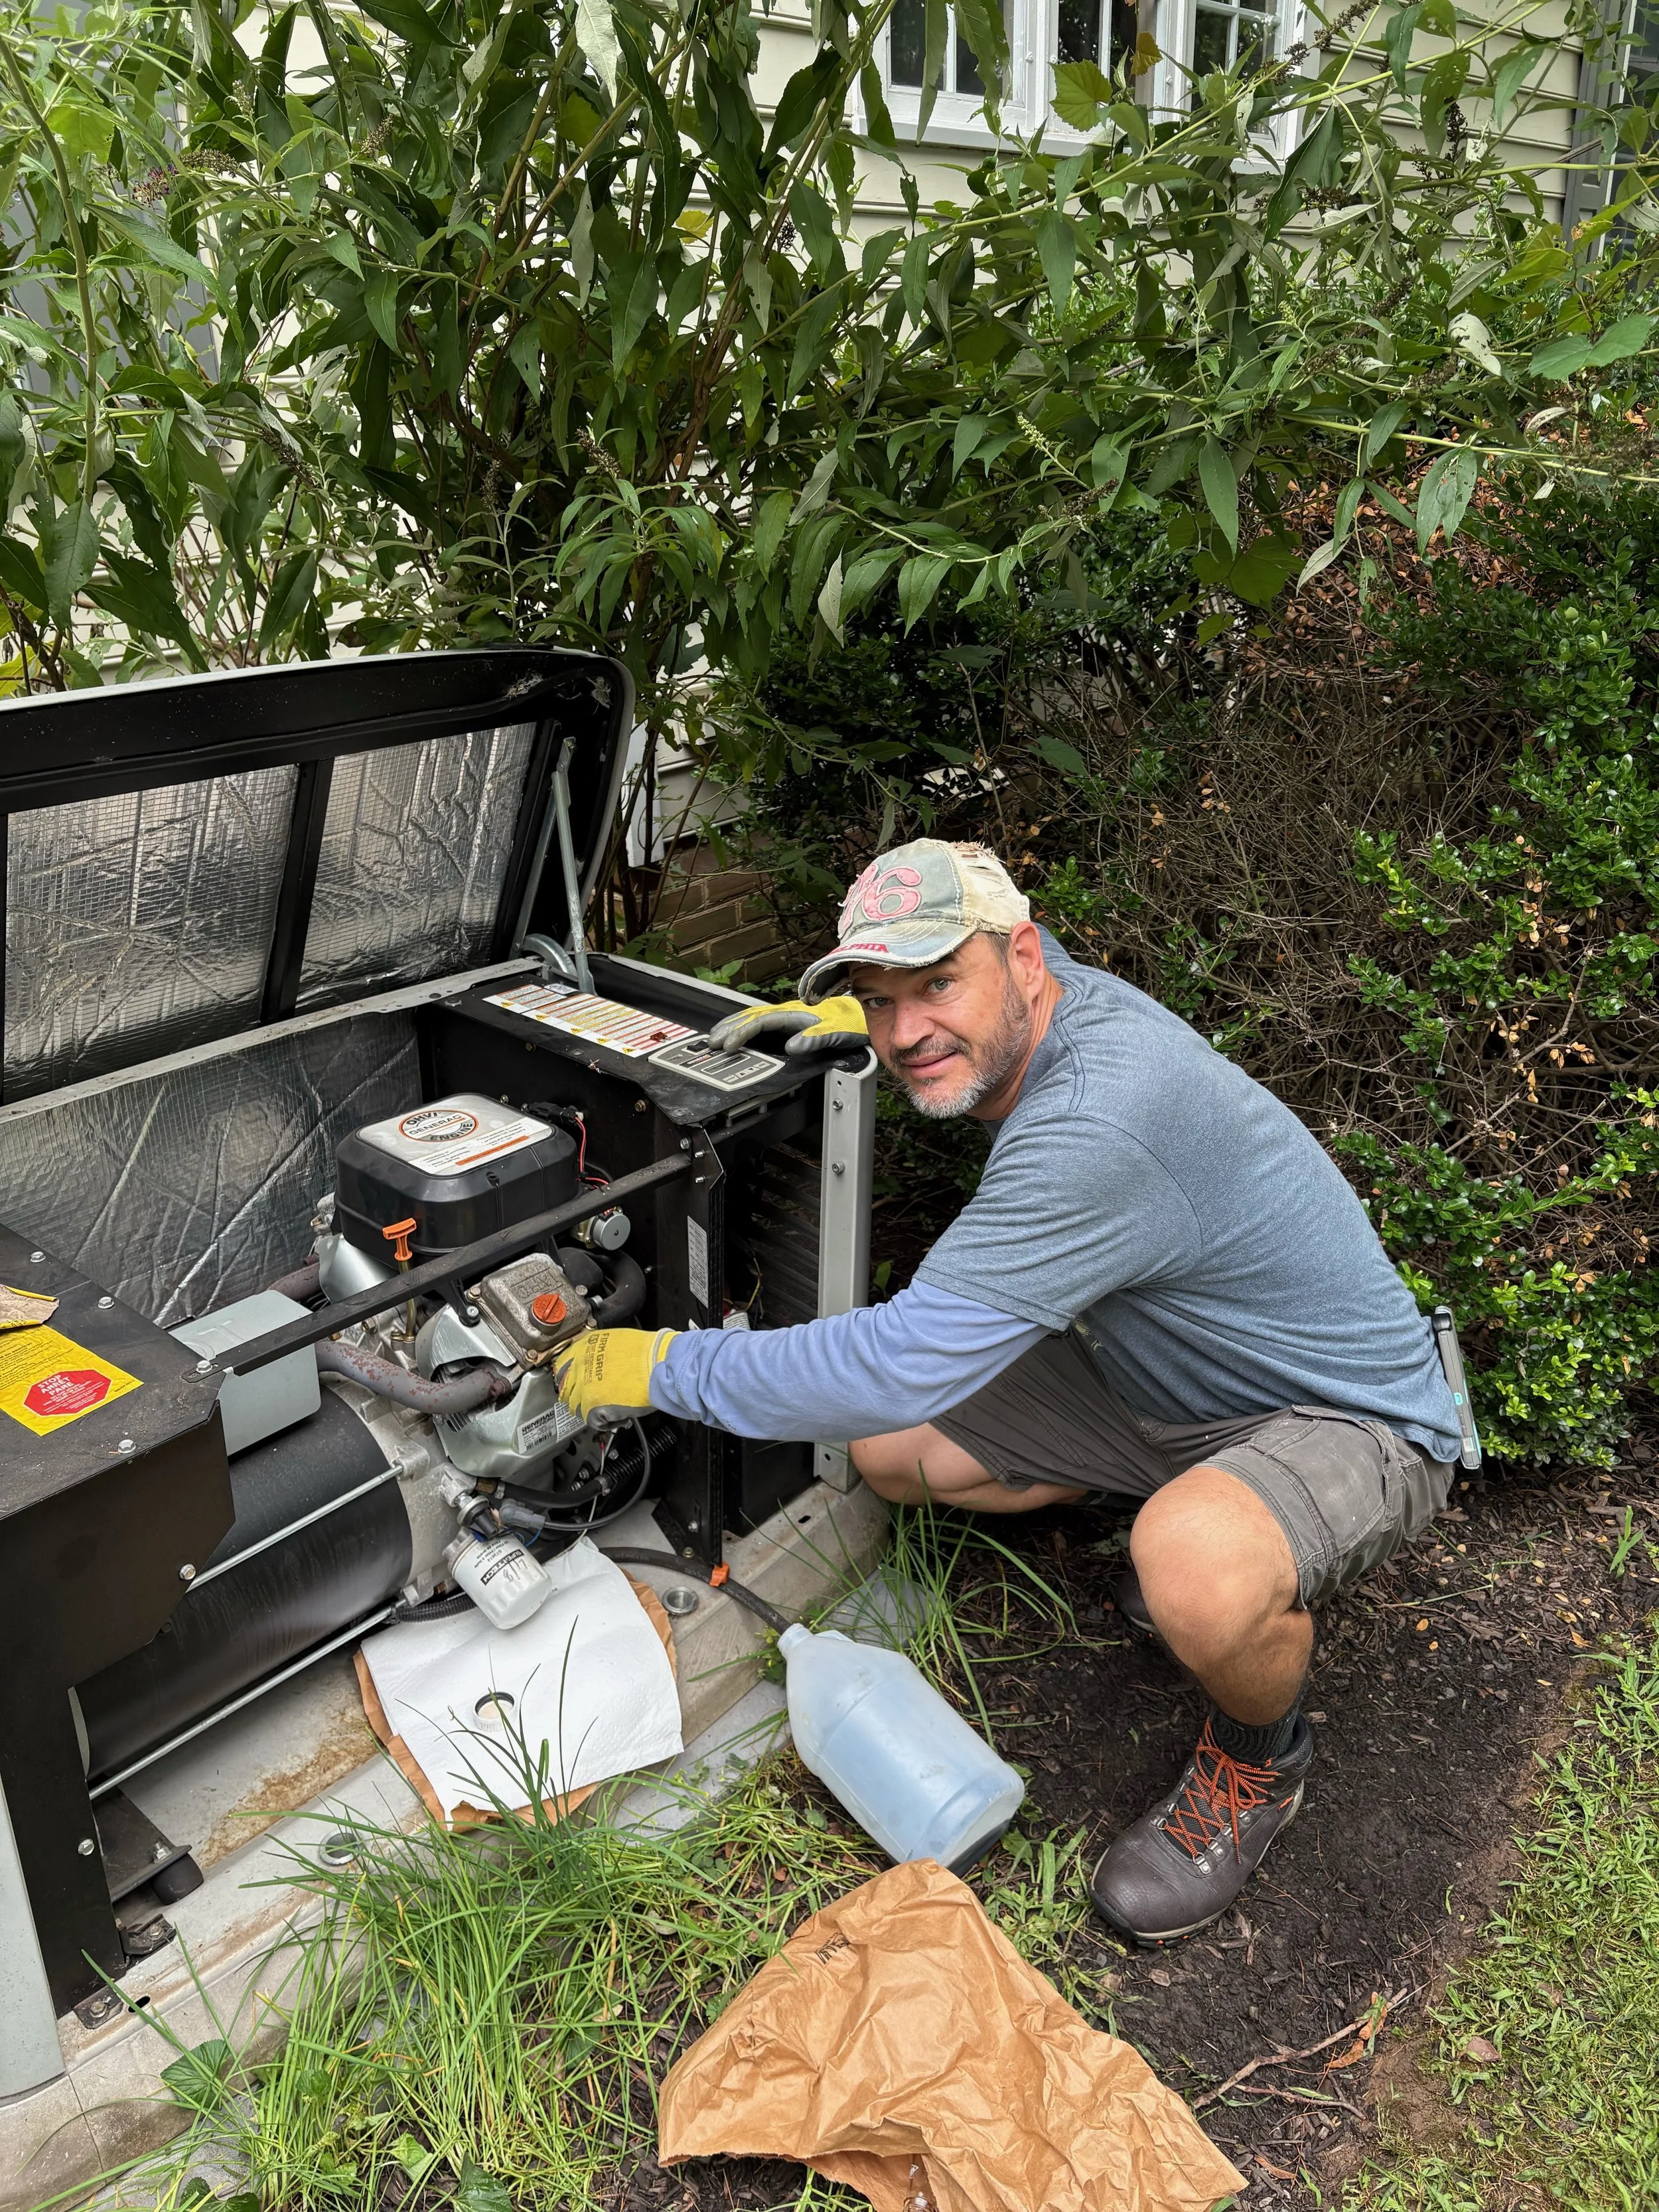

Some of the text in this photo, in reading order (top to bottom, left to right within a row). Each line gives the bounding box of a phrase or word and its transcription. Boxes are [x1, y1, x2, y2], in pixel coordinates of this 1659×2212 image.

[406, 1112, 437, 1125] OHVI
[409, 1114, 462, 1135] GENERAC
[430, 1123, 472, 1141] ENGINE
[595, 1333, 609, 1380] FIRM GRIP
[38, 1374, 61, 1388] STOP
[48, 1381, 74, 1396] PARE
[522, 1410, 555, 1432] GENERAC
